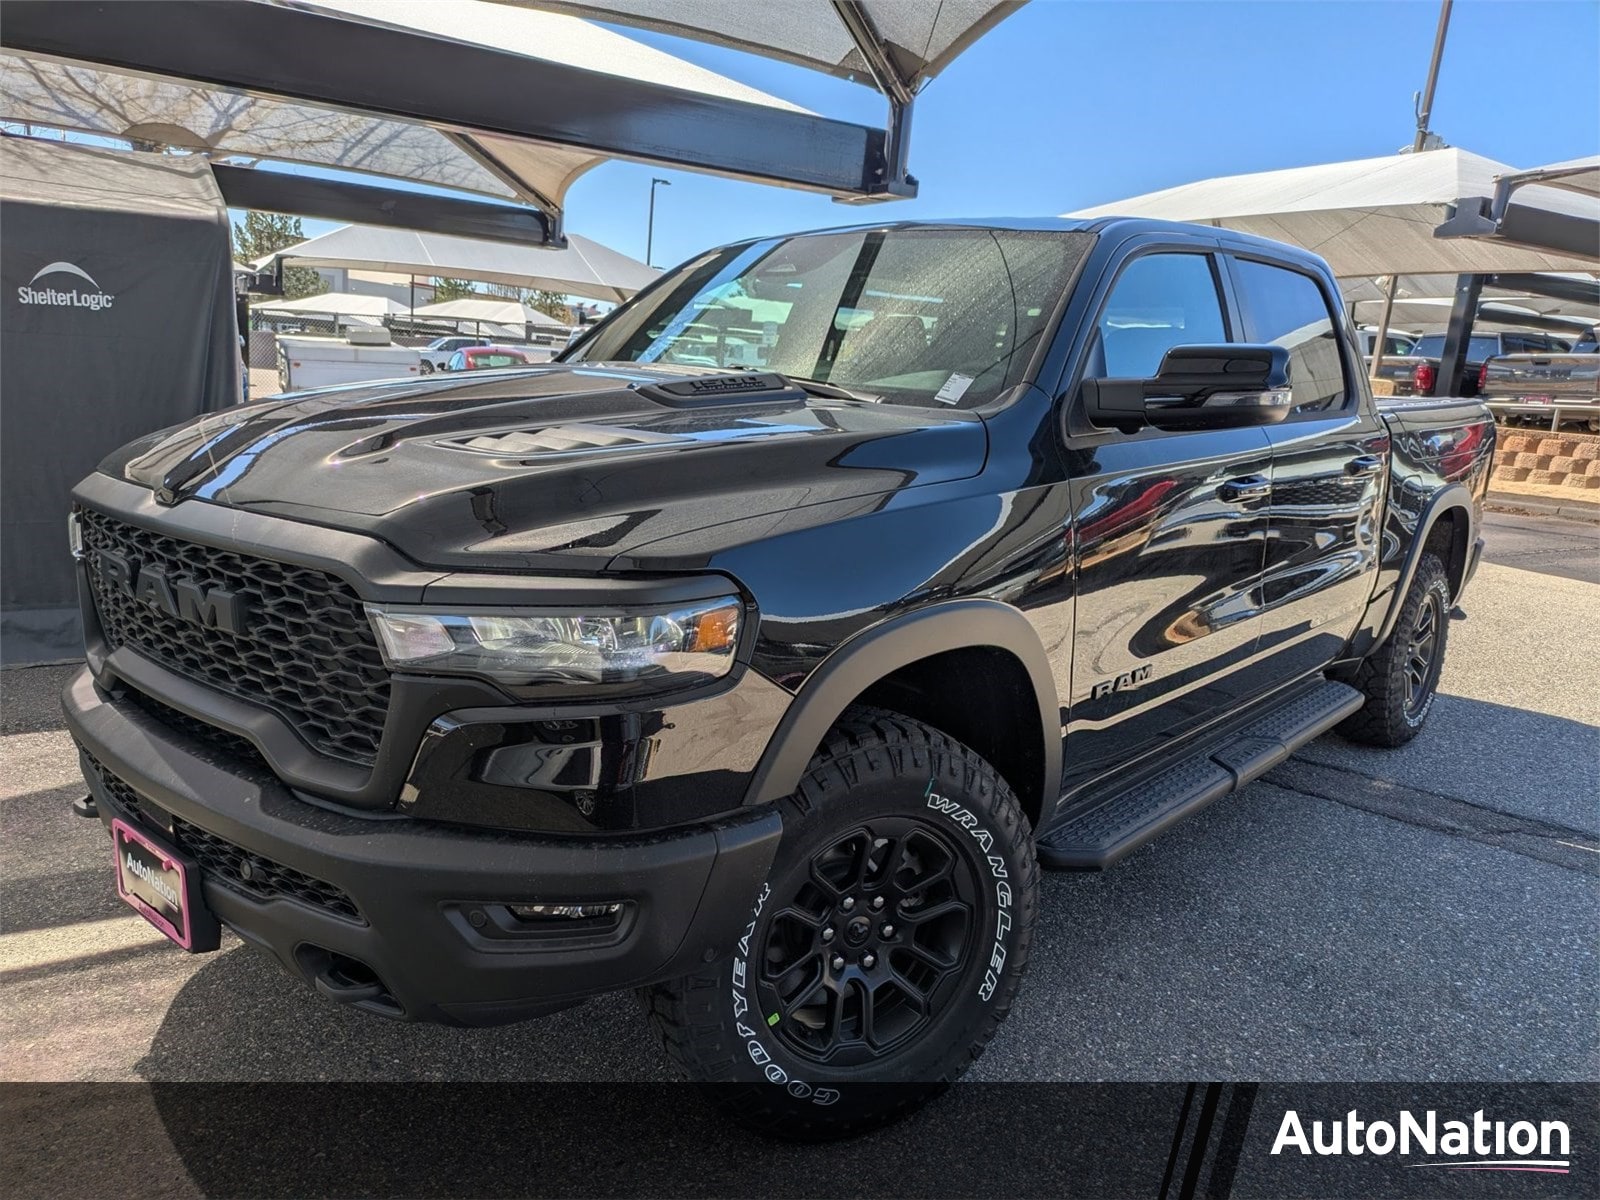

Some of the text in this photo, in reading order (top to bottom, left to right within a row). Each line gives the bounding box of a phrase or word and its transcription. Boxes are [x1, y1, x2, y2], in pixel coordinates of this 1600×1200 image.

[18, 286, 113, 311] ShelterLogic
[98, 550, 246, 637] RAM
[1091, 663, 1152, 700] RAM
[126, 852, 178, 906] AutoNation
[927, 793, 1012, 1001] WRANGLER
